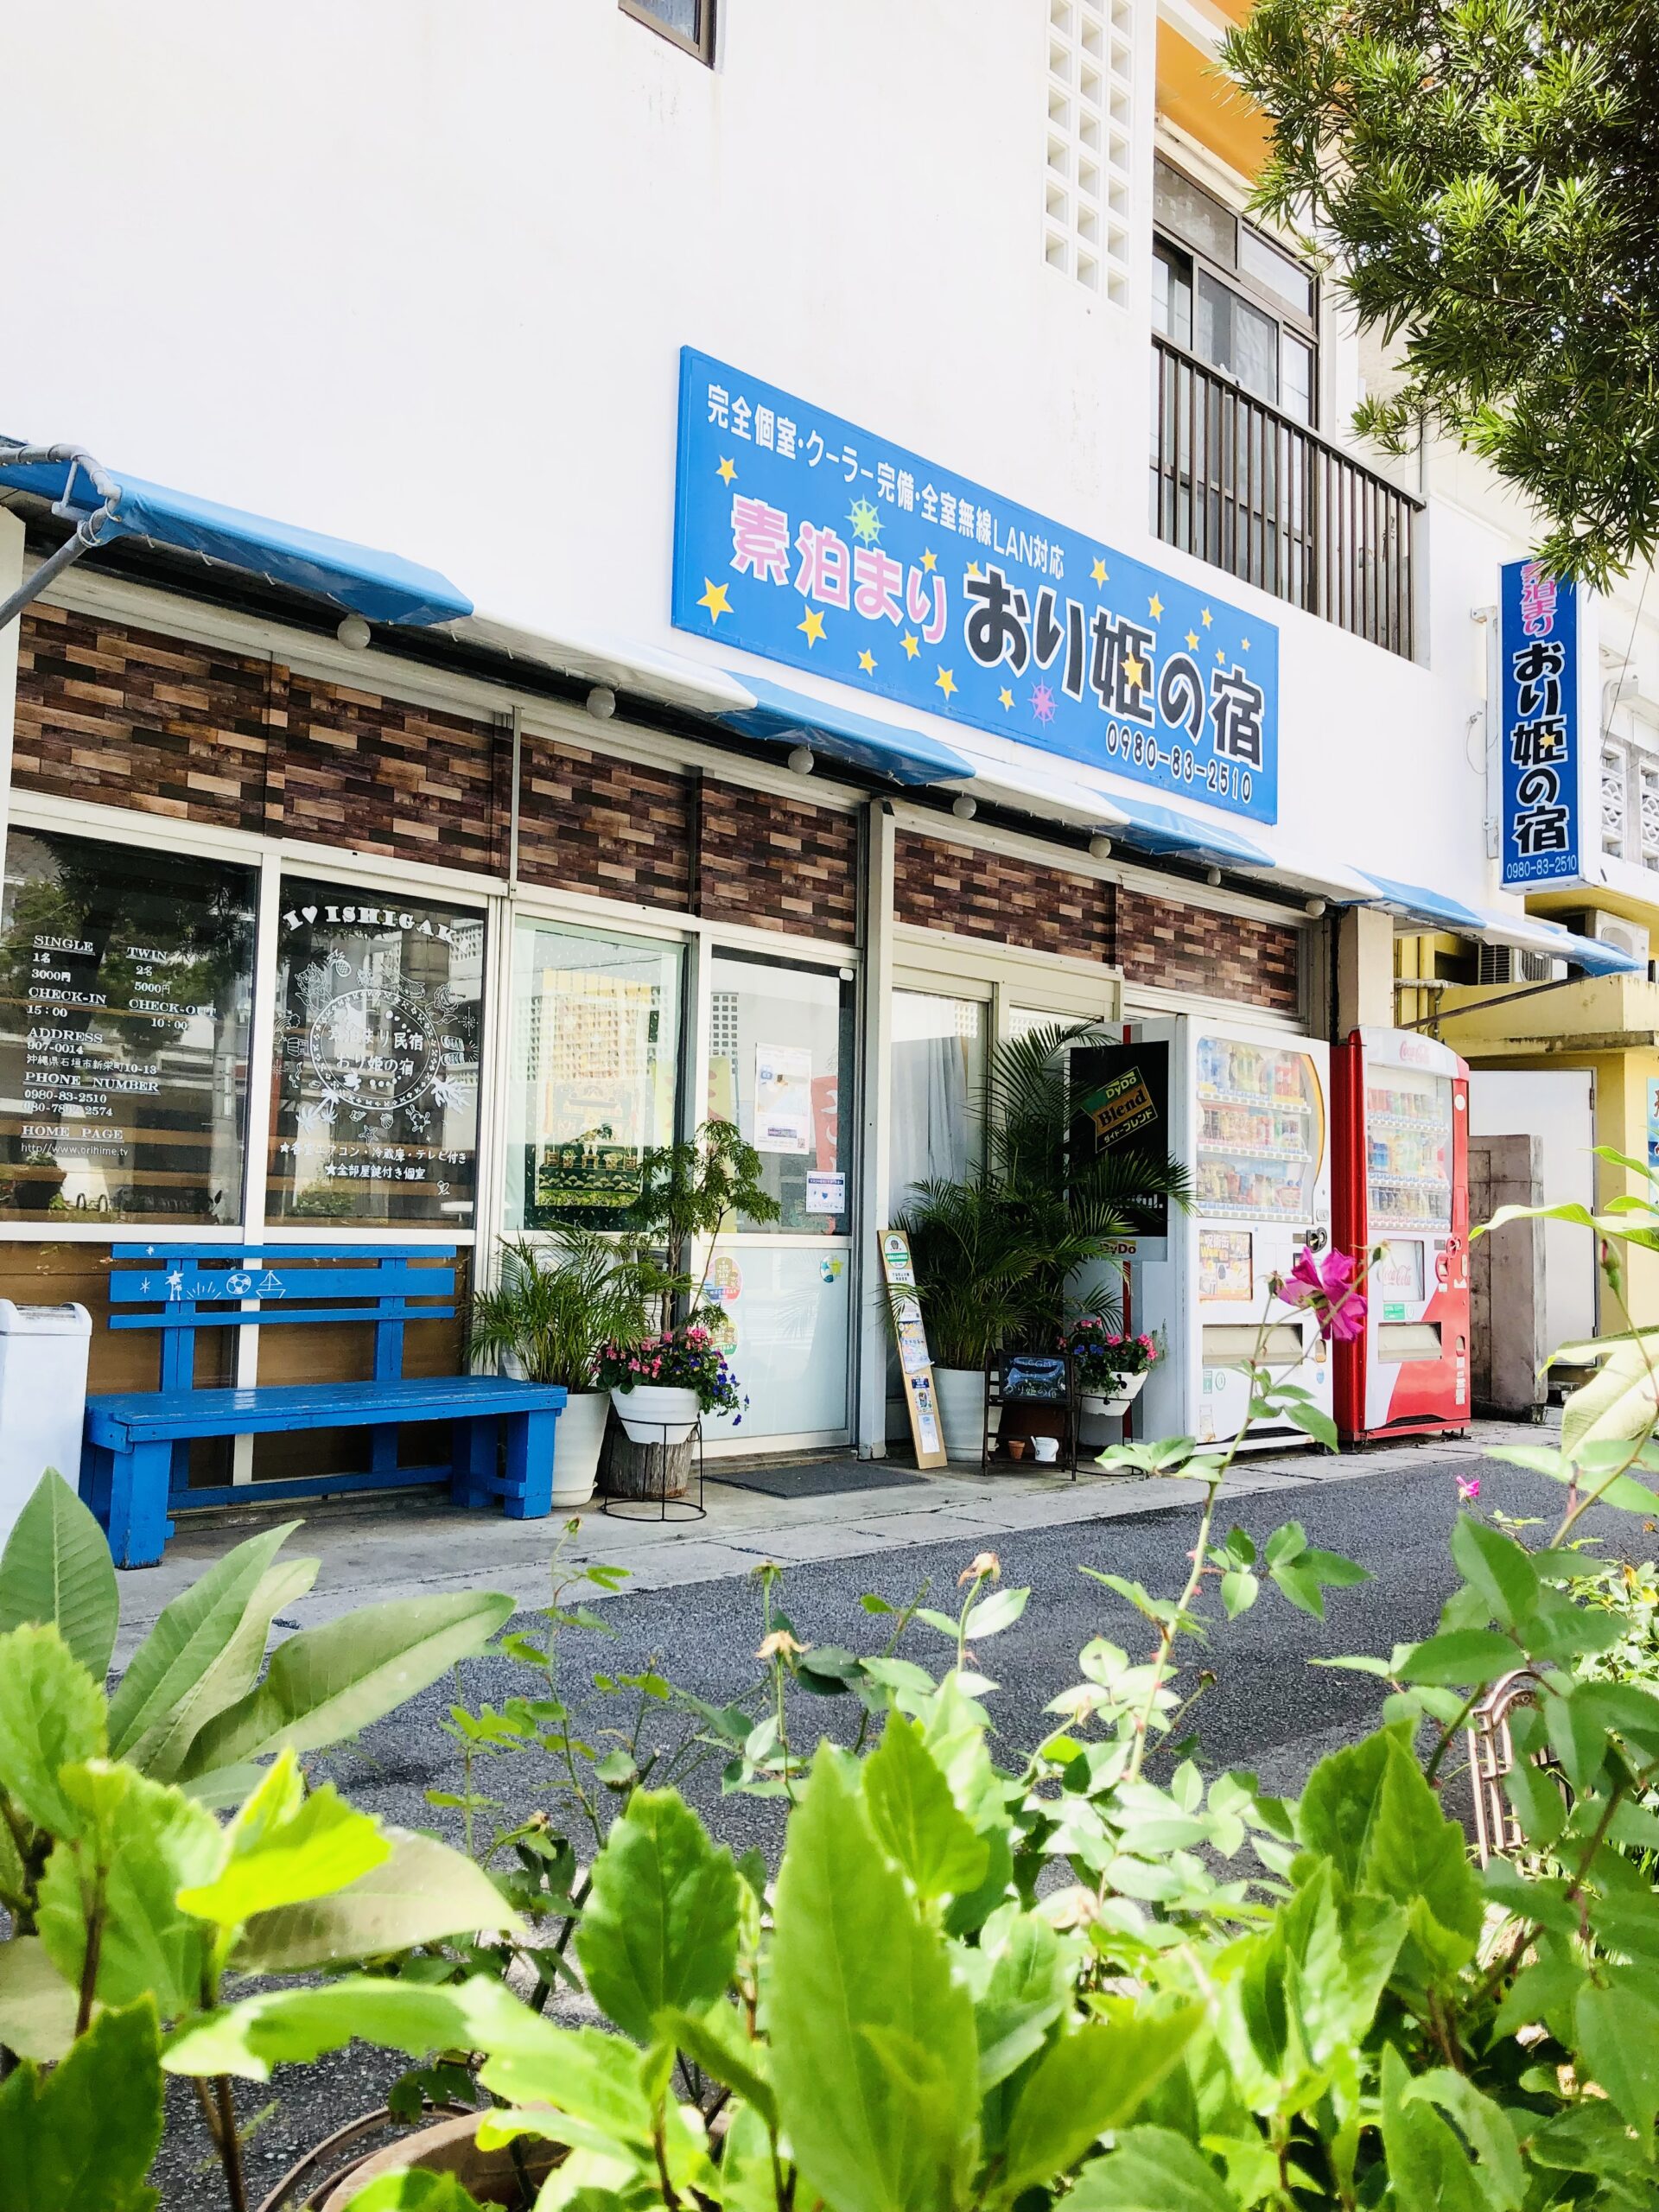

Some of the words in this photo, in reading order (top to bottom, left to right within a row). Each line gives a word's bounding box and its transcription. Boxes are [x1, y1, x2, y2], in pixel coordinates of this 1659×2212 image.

[730, 493, 947, 644] 素泊まり
[962, 563, 1264, 773] おり姫の宿
[1510, 639, 1570, 858] おり姫の宿
[1106, 720, 1253, 805] 0980-83-2510
[1507, 854, 1576, 880] 0980-83-2510
[34, 935, 94, 952] SINGLE
[33, 952, 51, 964] 1名
[128, 947, 168, 961] TWIN
[31, 969, 71, 983] 3000円
[136, 965, 153, 976] 2名
[29, 987, 107, 1005] CHECK-IN
[135, 982, 170, 995] 5000円
[129, 999, 217, 1017] CHECK-OUT
[29, 1027, 103, 1044] ADDRESS
[24, 1071, 81, 1086] PHONE
[92, 1077, 159, 1092] NUMBER
[1105, 1076, 1137, 1098] DyDo
[24, 1089, 107, 1103] 0980-83-2510
[1098, 1089, 1147, 1128] Blend
[22, 1125, 70, 1137] HOME
[81, 1128, 124, 1140] PAGE
